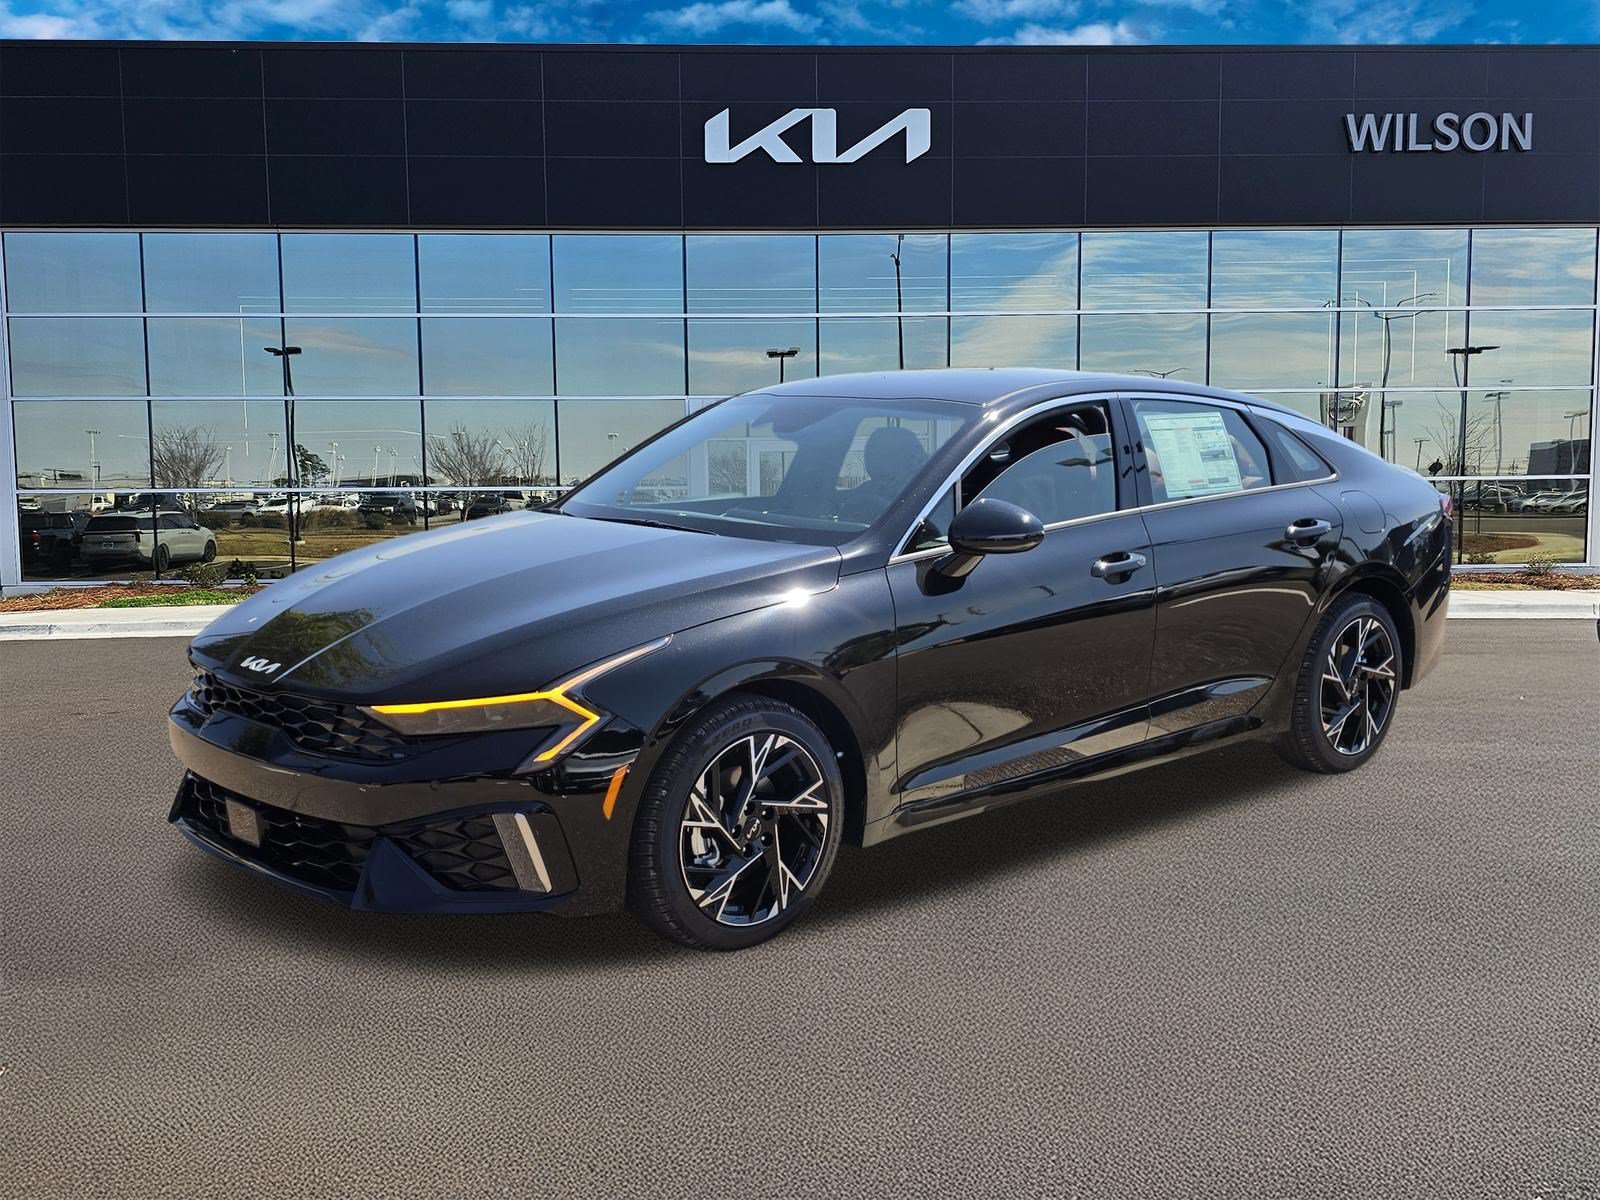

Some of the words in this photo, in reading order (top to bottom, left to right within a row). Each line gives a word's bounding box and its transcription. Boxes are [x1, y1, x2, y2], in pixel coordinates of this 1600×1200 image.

[704, 107, 931, 164] KIA
[1345, 112, 1534, 152] WILSON
[240, 655, 282, 674] KIA
